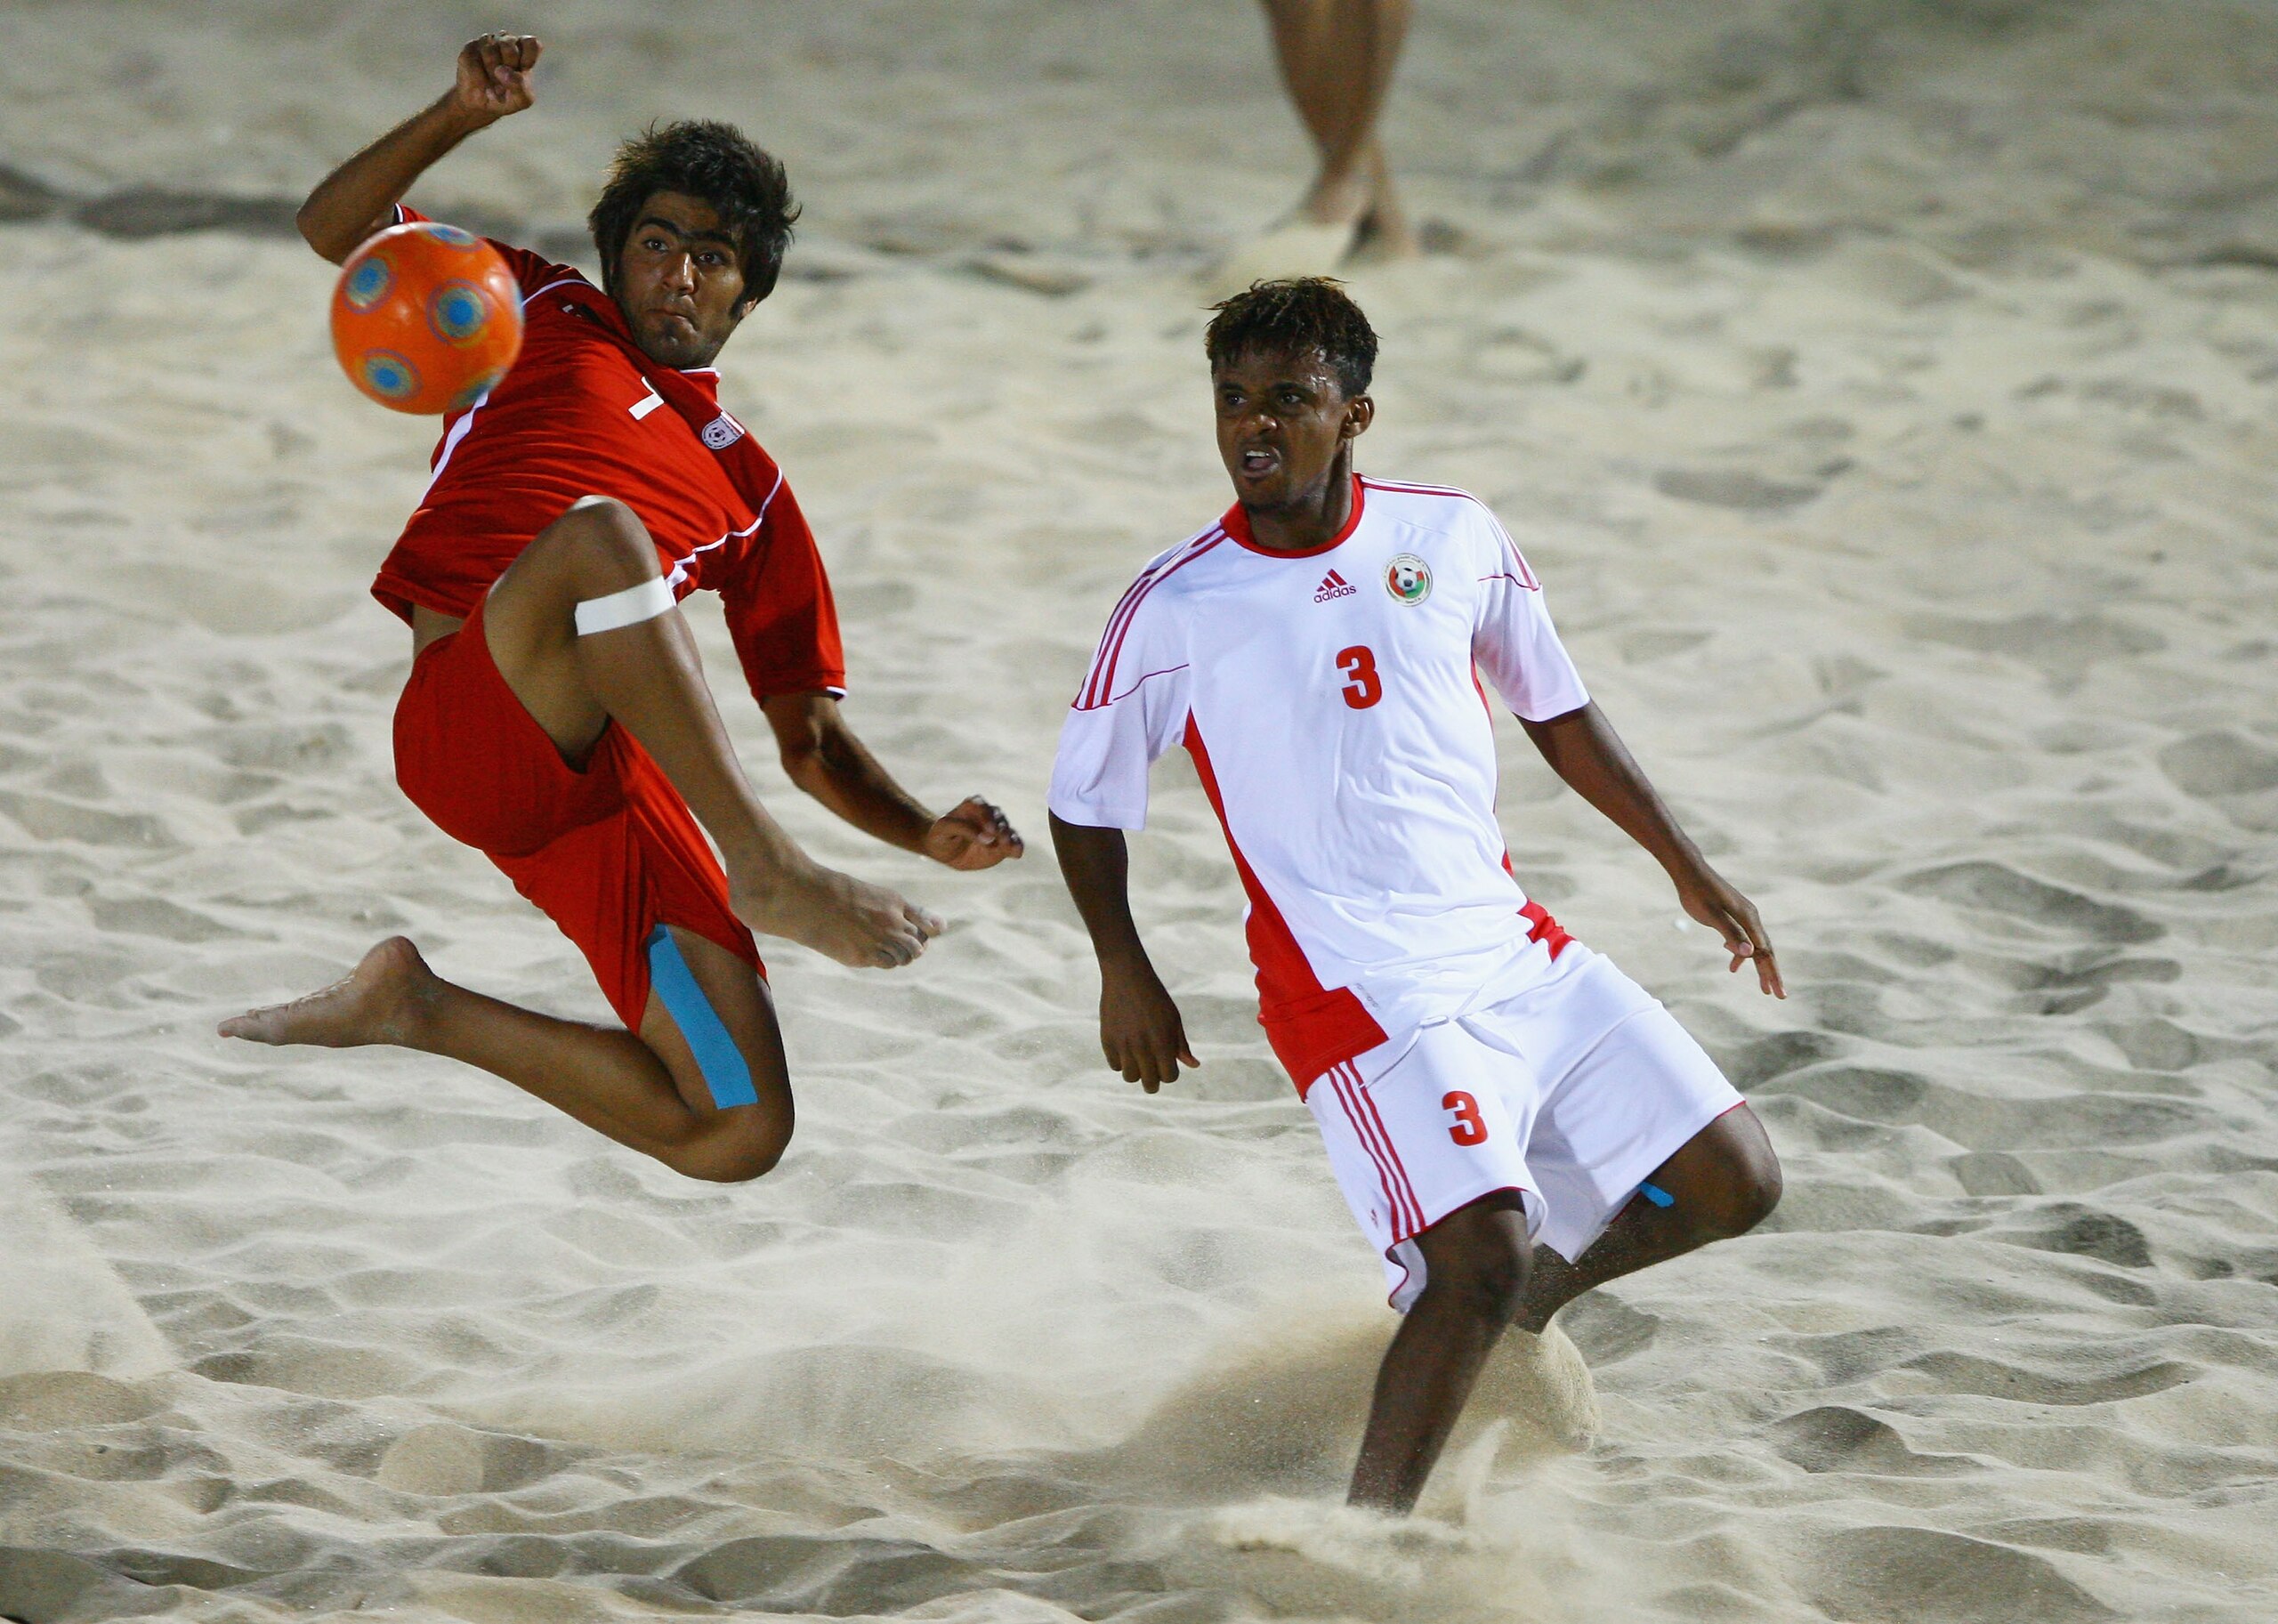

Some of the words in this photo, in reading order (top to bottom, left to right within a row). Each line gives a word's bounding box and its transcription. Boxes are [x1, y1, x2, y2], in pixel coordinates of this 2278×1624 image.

[1313, 585, 1357, 603] adidas
[1336, 645, 1382, 709] 3
[1442, 1091, 1488, 1146] 3
